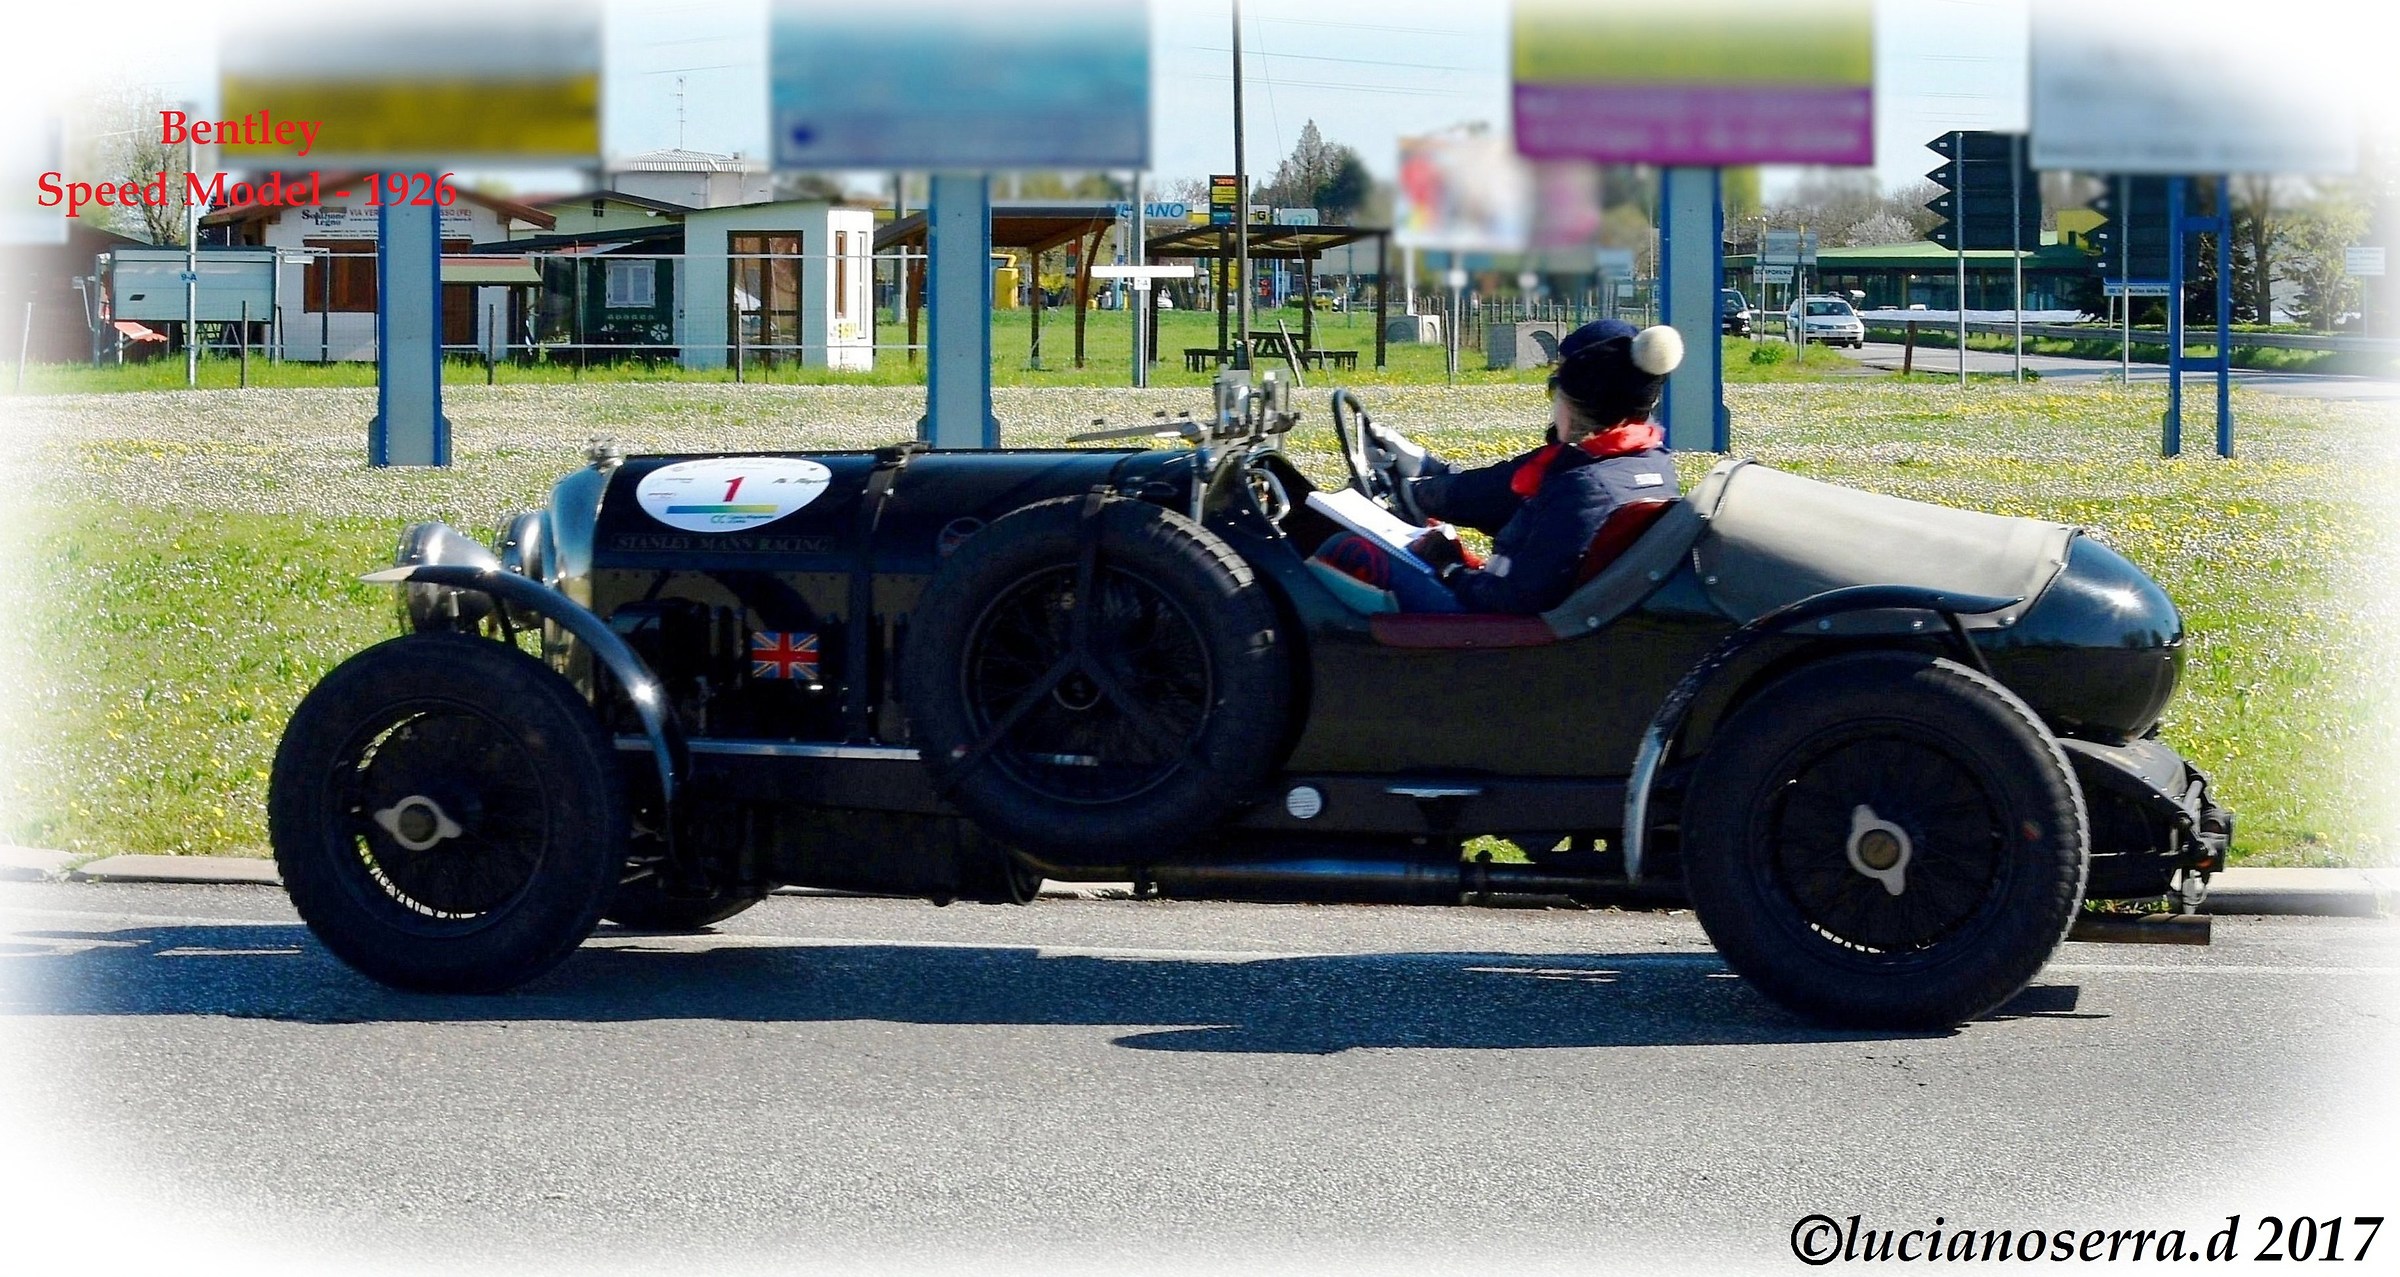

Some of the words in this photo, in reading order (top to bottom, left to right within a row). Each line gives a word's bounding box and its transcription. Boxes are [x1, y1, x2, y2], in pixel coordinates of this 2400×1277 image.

[724, 476, 746, 502] 1
[617, 535, 690, 550] STANLEY
[758, 535, 829, 551] RACING
